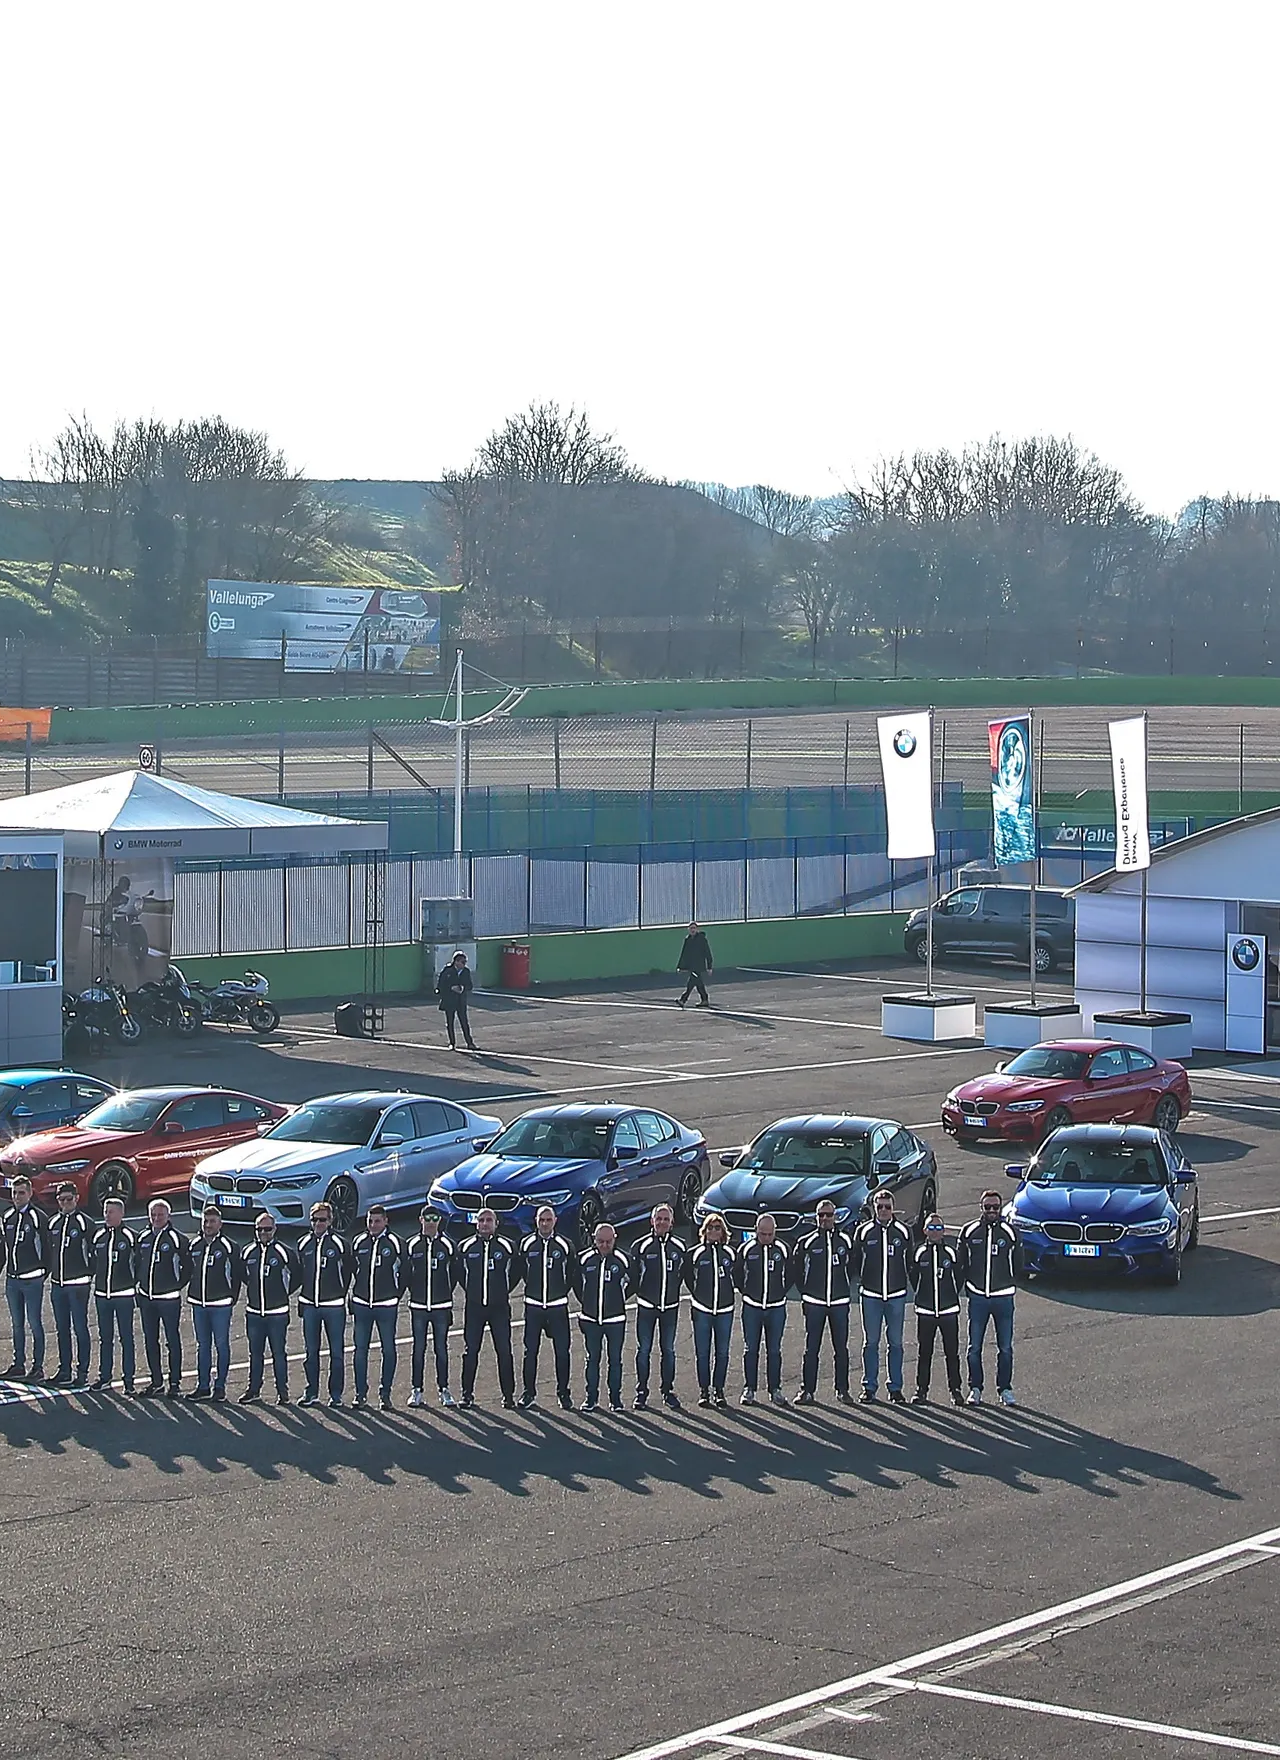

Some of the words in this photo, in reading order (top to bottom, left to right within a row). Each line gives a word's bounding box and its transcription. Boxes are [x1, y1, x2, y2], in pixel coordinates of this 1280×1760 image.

[210, 590, 264, 608] Vallelunga
[128, 840, 147, 848] BMW
[149, 840, 182, 848] Motorrad
